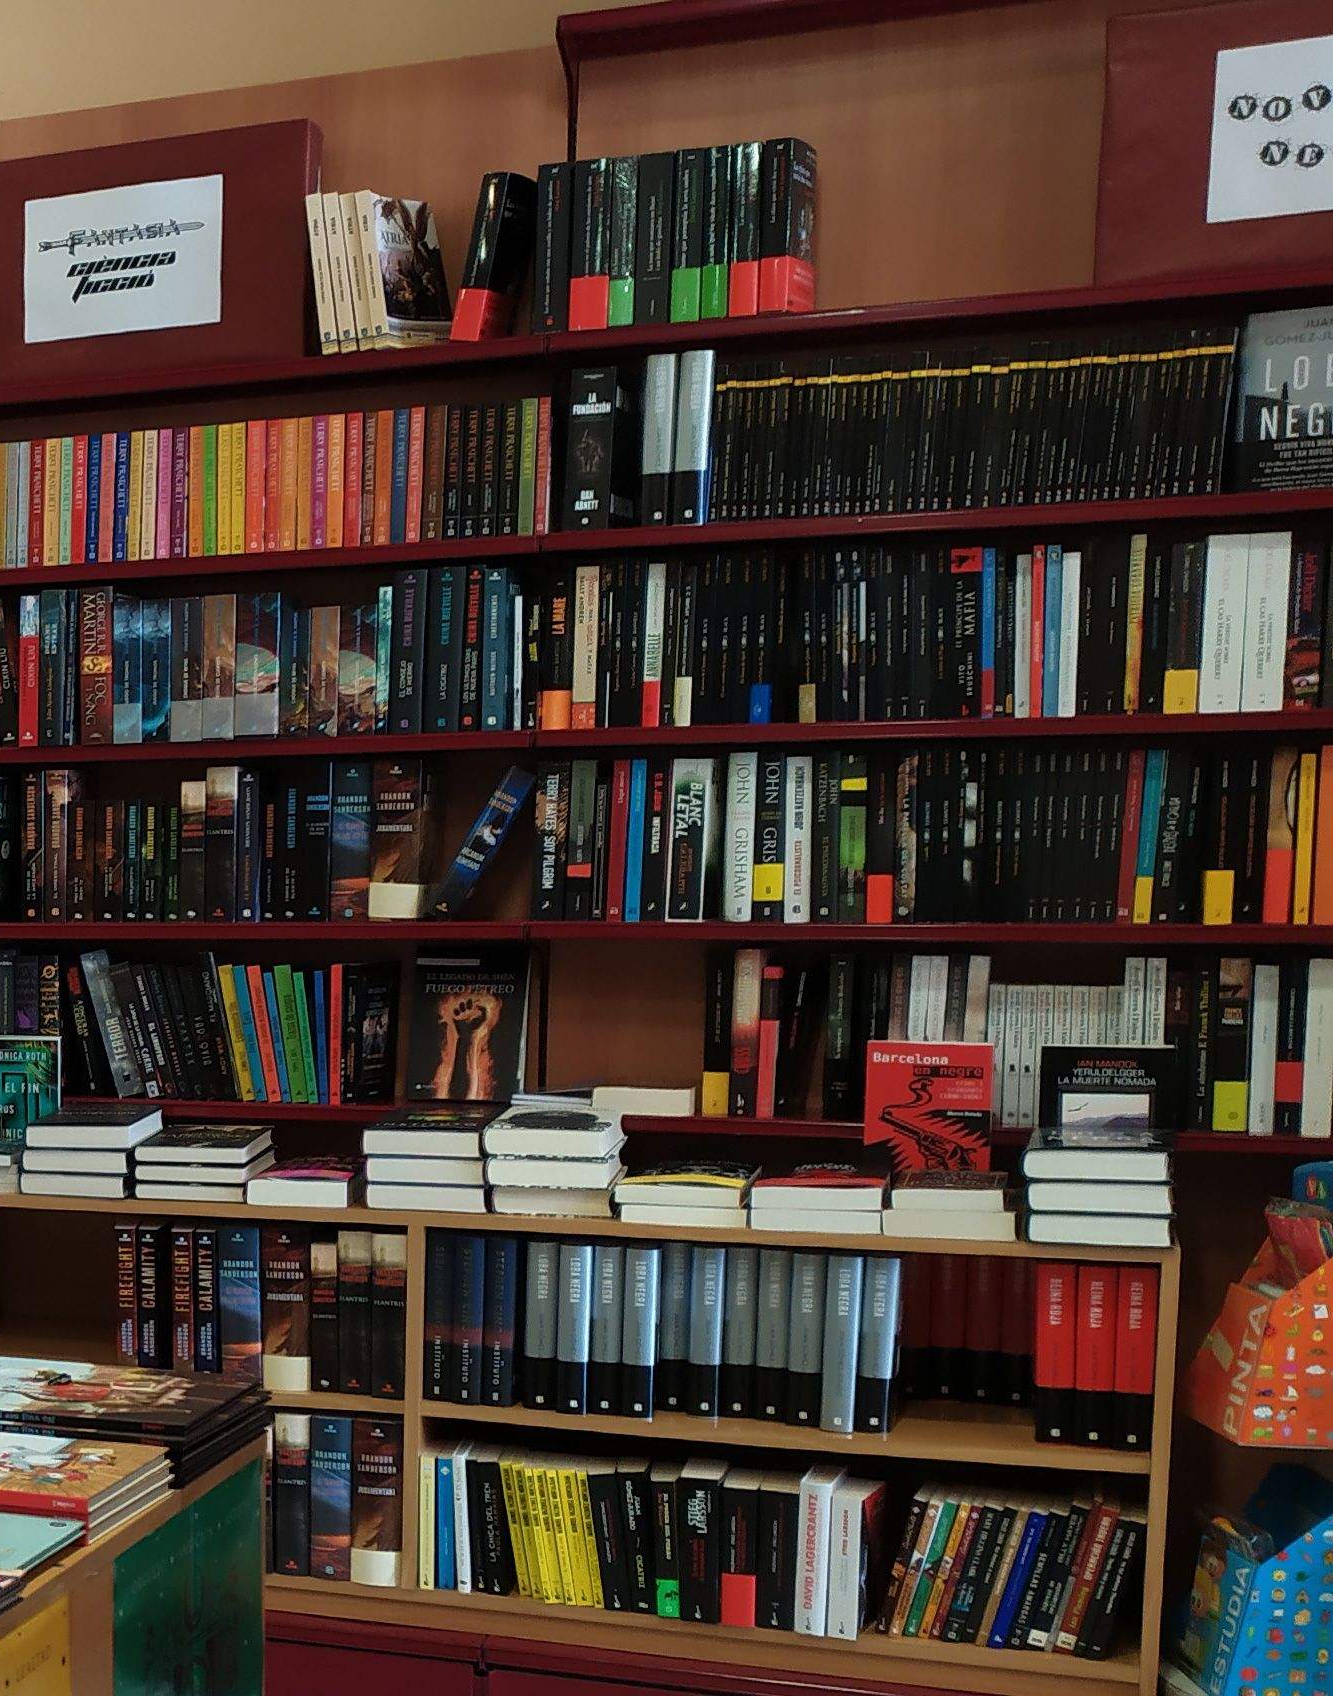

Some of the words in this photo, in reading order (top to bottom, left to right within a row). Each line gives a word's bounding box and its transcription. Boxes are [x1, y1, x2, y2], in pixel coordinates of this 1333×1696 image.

[572, 401, 612, 416] FUNDACIÓN
[588, 392, 597, 403] LA
[1260, 402, 1333, 440] NEG
[574, 499, 599, 511] ABNETT
[579, 489, 595, 501] DAN
[964, 590, 977, 635] MAFIA
[735, 763, 751, 804] JOHN
[763, 761, 781, 804] JOHN
[675, 795, 689, 839] LETAL
[689, 782, 704, 827] BLANC
[733, 827, 751, 900] GRISHAM
[761, 827, 777, 863] GRIS
[425, 984, 459, 995] FUEGO
[24, 1050, 47, 1062] ROTH
[872, 1052, 949, 1065] Barcelona
[914, 1068, 934, 1076] en
[940, 1067, 983, 1077] negre
[1077, 1060, 1093, 1068] IAN
[4, 1082, 17, 1094] EL
[20, 1081, 40, 1094] FIN
[1057, 1077, 1070, 1085] LA
[1072, 1076, 1112, 1085] MUERTE
[1114, 1075, 1157, 1086] NÓMADA
[119, 1246, 133, 1308] FIREFIGHT
[141, 1246, 155, 1308] CALAMITY
[175, 1250, 190, 1313] FIREFIGHT
[198, 1247, 213, 1312] CALAMITY
[1222, 1302, 1268, 1438] PINTA
[687, 1498, 697, 1526] STIEG
[697, 1490, 708, 1534] LARSSON
[804, 1494, 819, 1577] LAGERCRANTZ
[802, 1581, 813, 1610] DAVID
[1208, 1566, 1252, 1695] ESTUDIA
